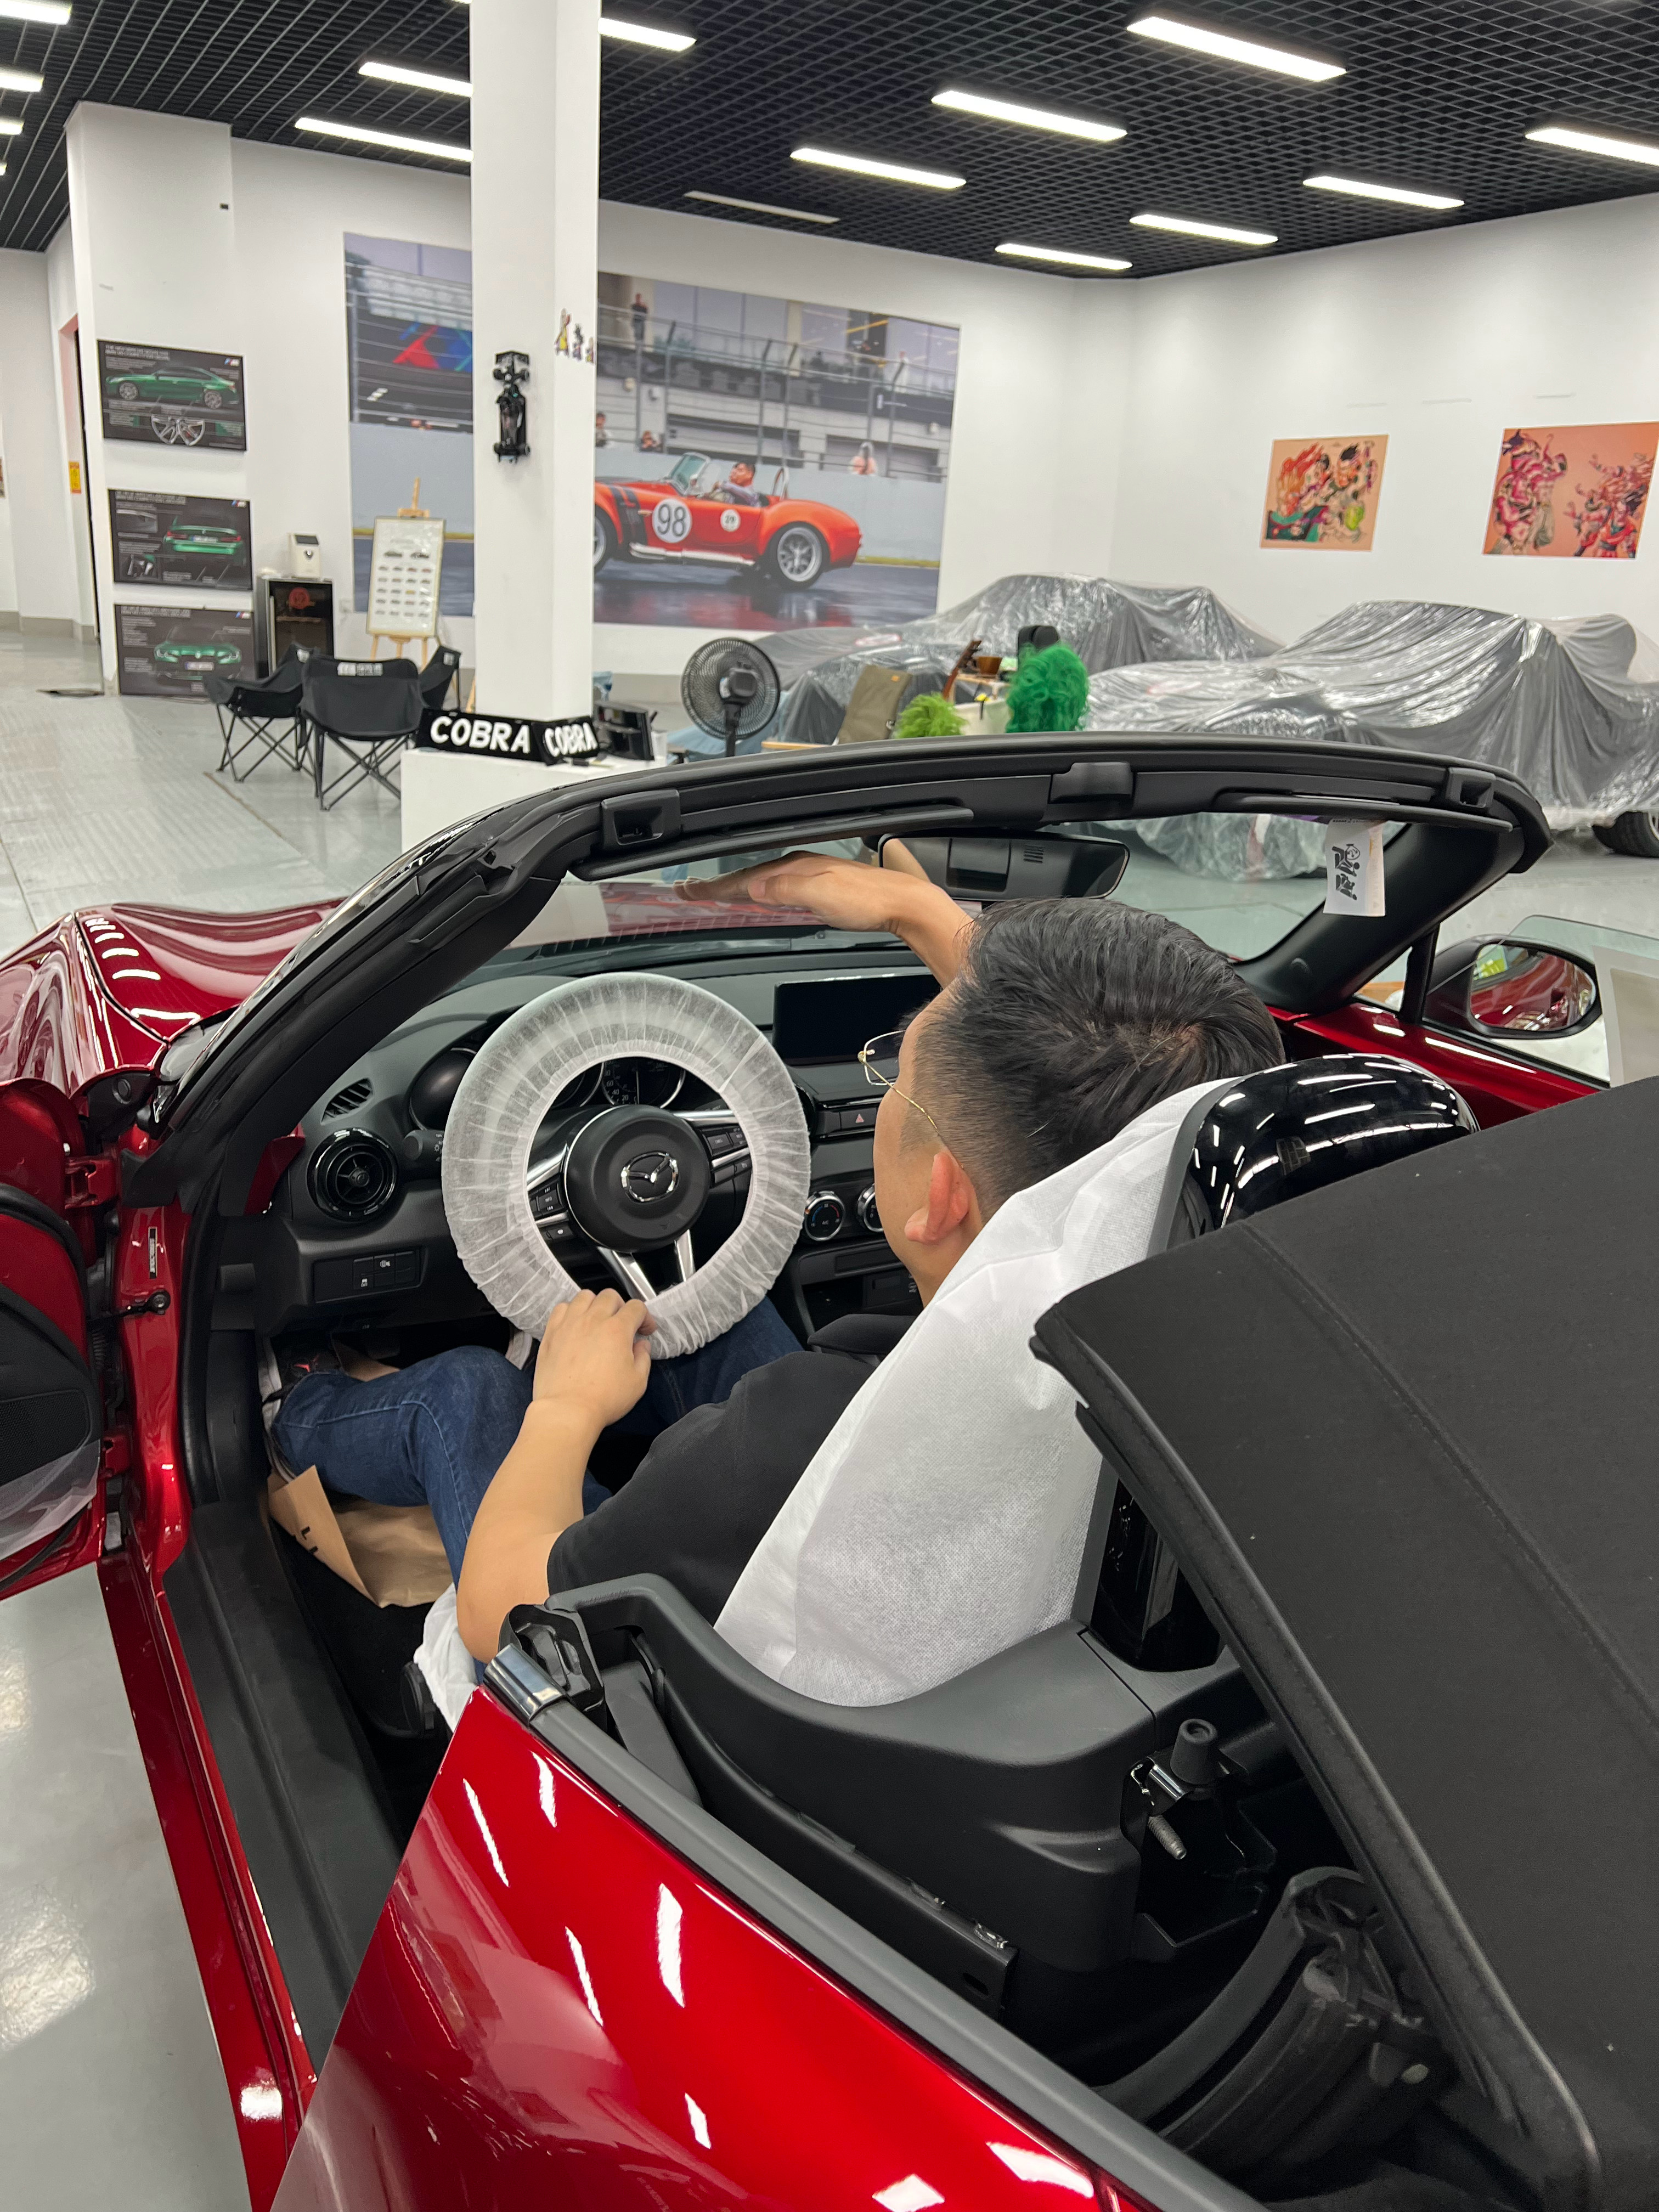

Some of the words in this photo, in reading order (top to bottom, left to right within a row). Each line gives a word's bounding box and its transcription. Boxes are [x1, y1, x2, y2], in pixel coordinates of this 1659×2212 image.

[657, 504, 685, 537] 98
[430, 716, 531, 754] COBRA
[544, 722, 598, 757] COBRA
